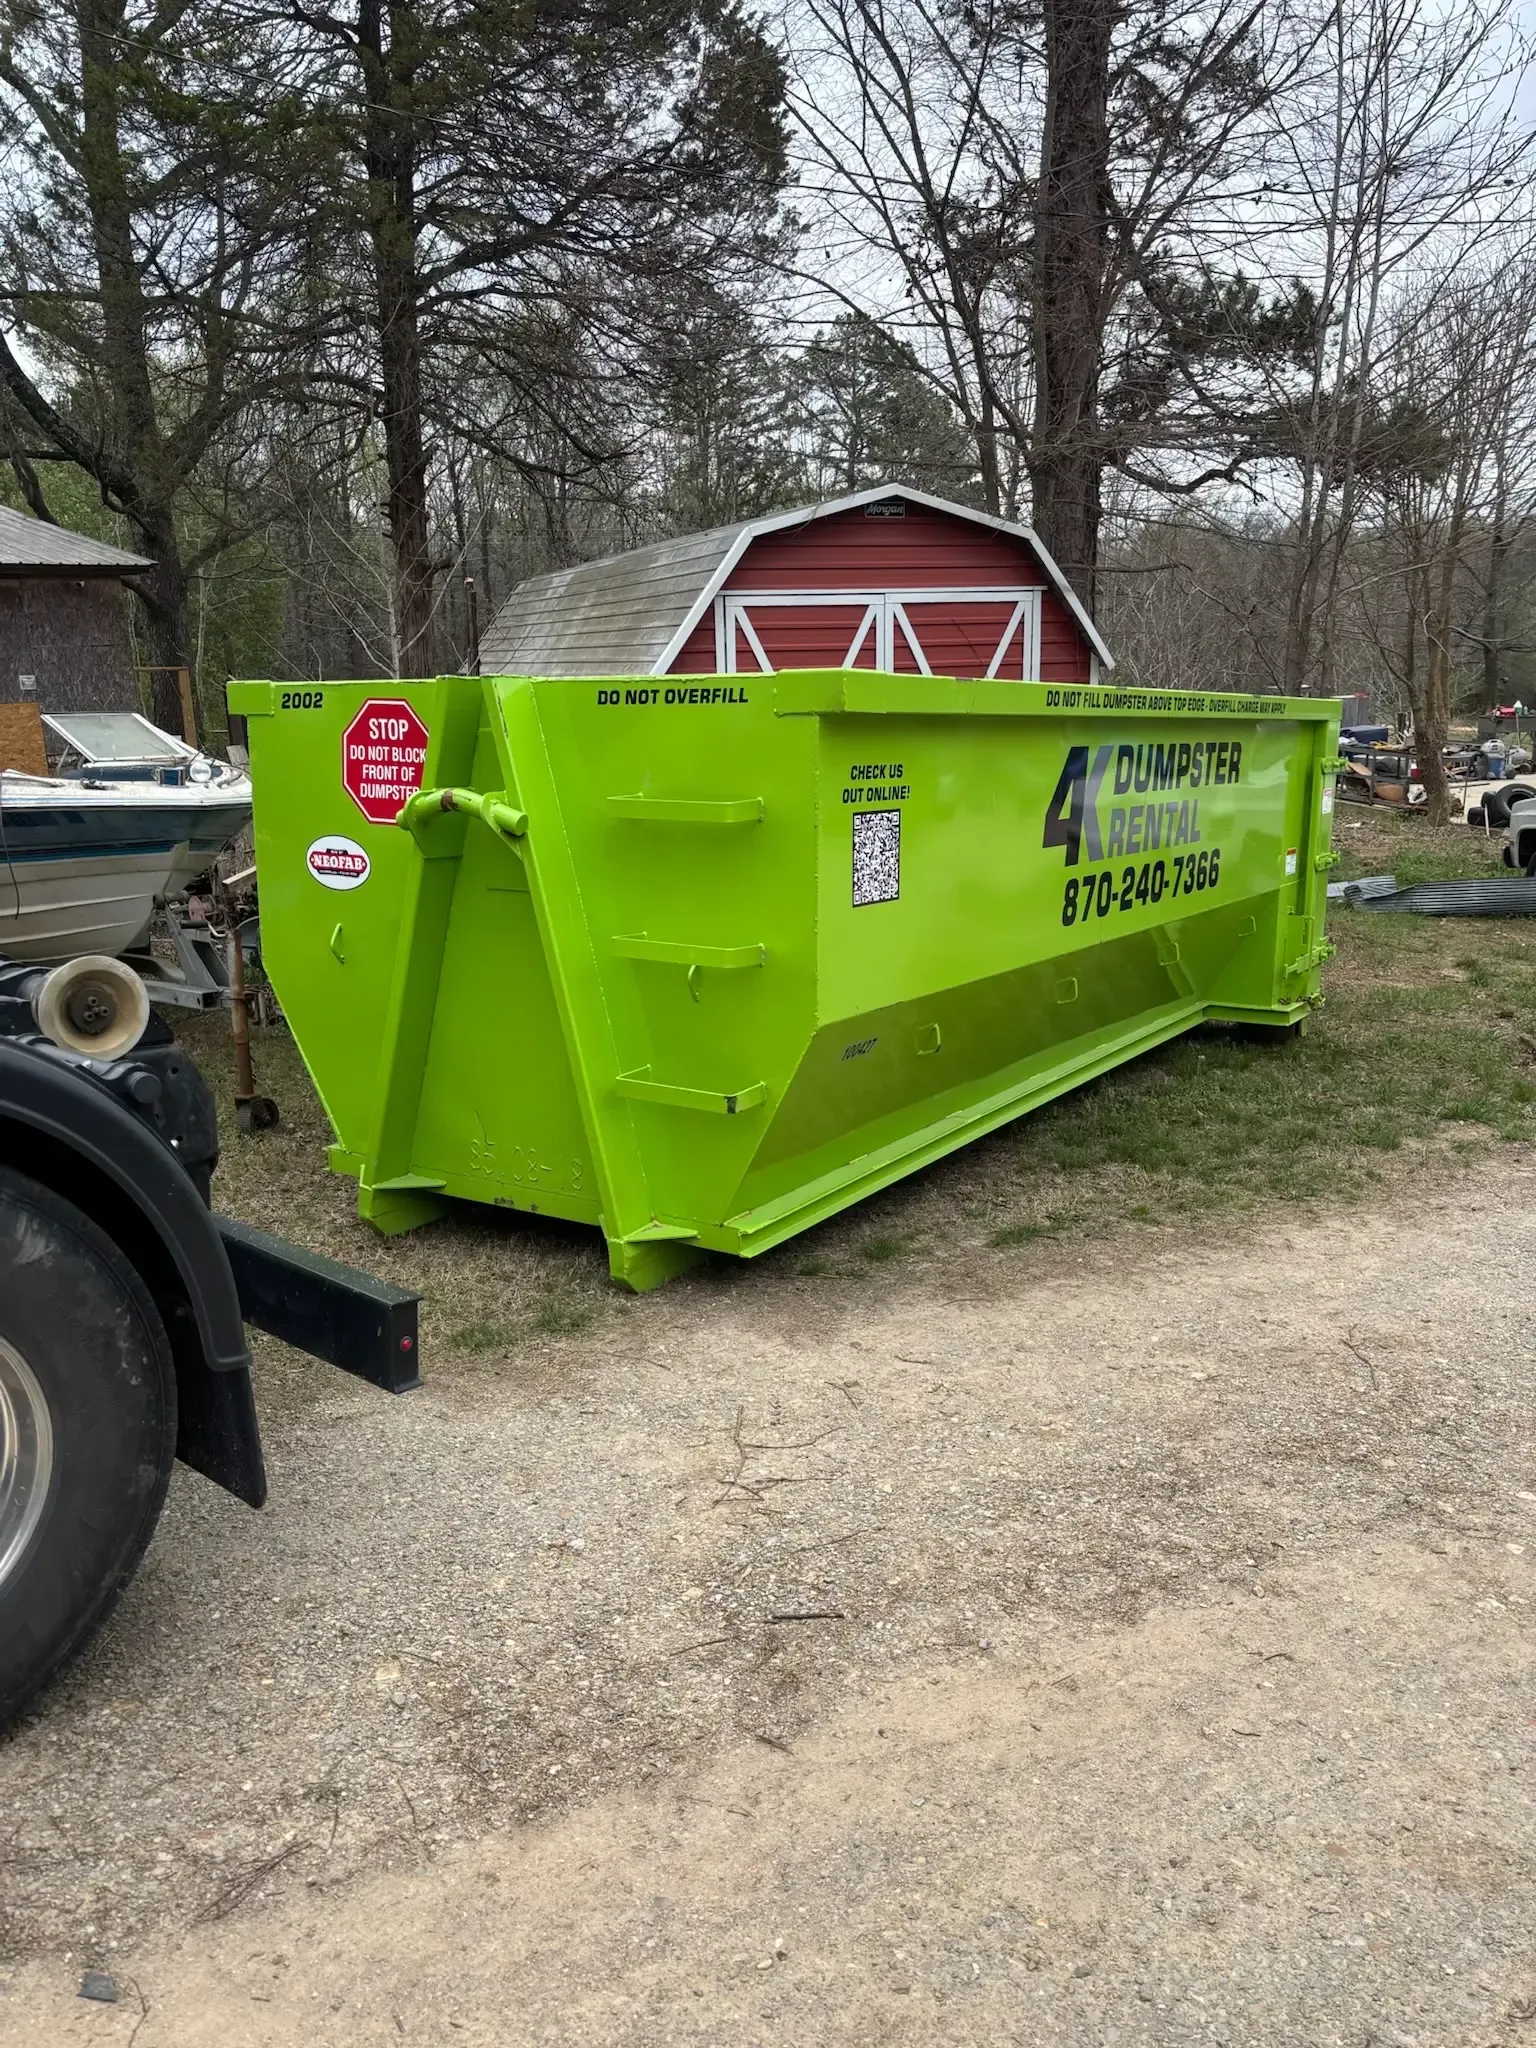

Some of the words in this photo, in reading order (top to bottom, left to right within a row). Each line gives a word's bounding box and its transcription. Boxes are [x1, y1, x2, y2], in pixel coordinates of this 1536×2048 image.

[281, 692, 323, 709] 2002
[597, 690, 620, 705] DO
[625, 689, 660, 705] NOT
[664, 687, 749, 704] OVERFILL
[1046, 690, 1060, 707] DO
[1062, 691, 1082, 708] NOT
[1083, 692, 1101, 708] FILL
[1103, 693, 1147, 710] DUMPSTER
[1147, 695, 1172, 711] ABOVE
[1173, 696, 1187, 711] TOP
[1187, 697, 1205, 712] EDGE
[1208, 698, 1236, 713] OVERFILL
[1237, 700, 1259, 714] CHARGE
[1259, 701, 1271, 714] MAY
[1271, 702, 1287, 715] APPLY
[368, 717, 409, 741] STOP
[349, 744, 366, 761] DO
[367, 745, 390, 762] NOT
[391, 746, 427, 764] BLOCK
[362, 764, 399, 781] FRONT
[400, 766, 416, 782] OF
[850, 764, 886, 780] CHECK
[889, 763, 903, 779] US
[1113, 741, 1242, 795] DUMPSTER
[842, 787, 864, 804] OUT
[866, 785, 910, 802] ONLINE!
[1042, 745, 1114, 867] 4K
[1107, 799, 1200, 859] RENTAL
[313, 853, 363, 870] NEOFAB
[1061, 848, 1221, 927] 870-240-7366
